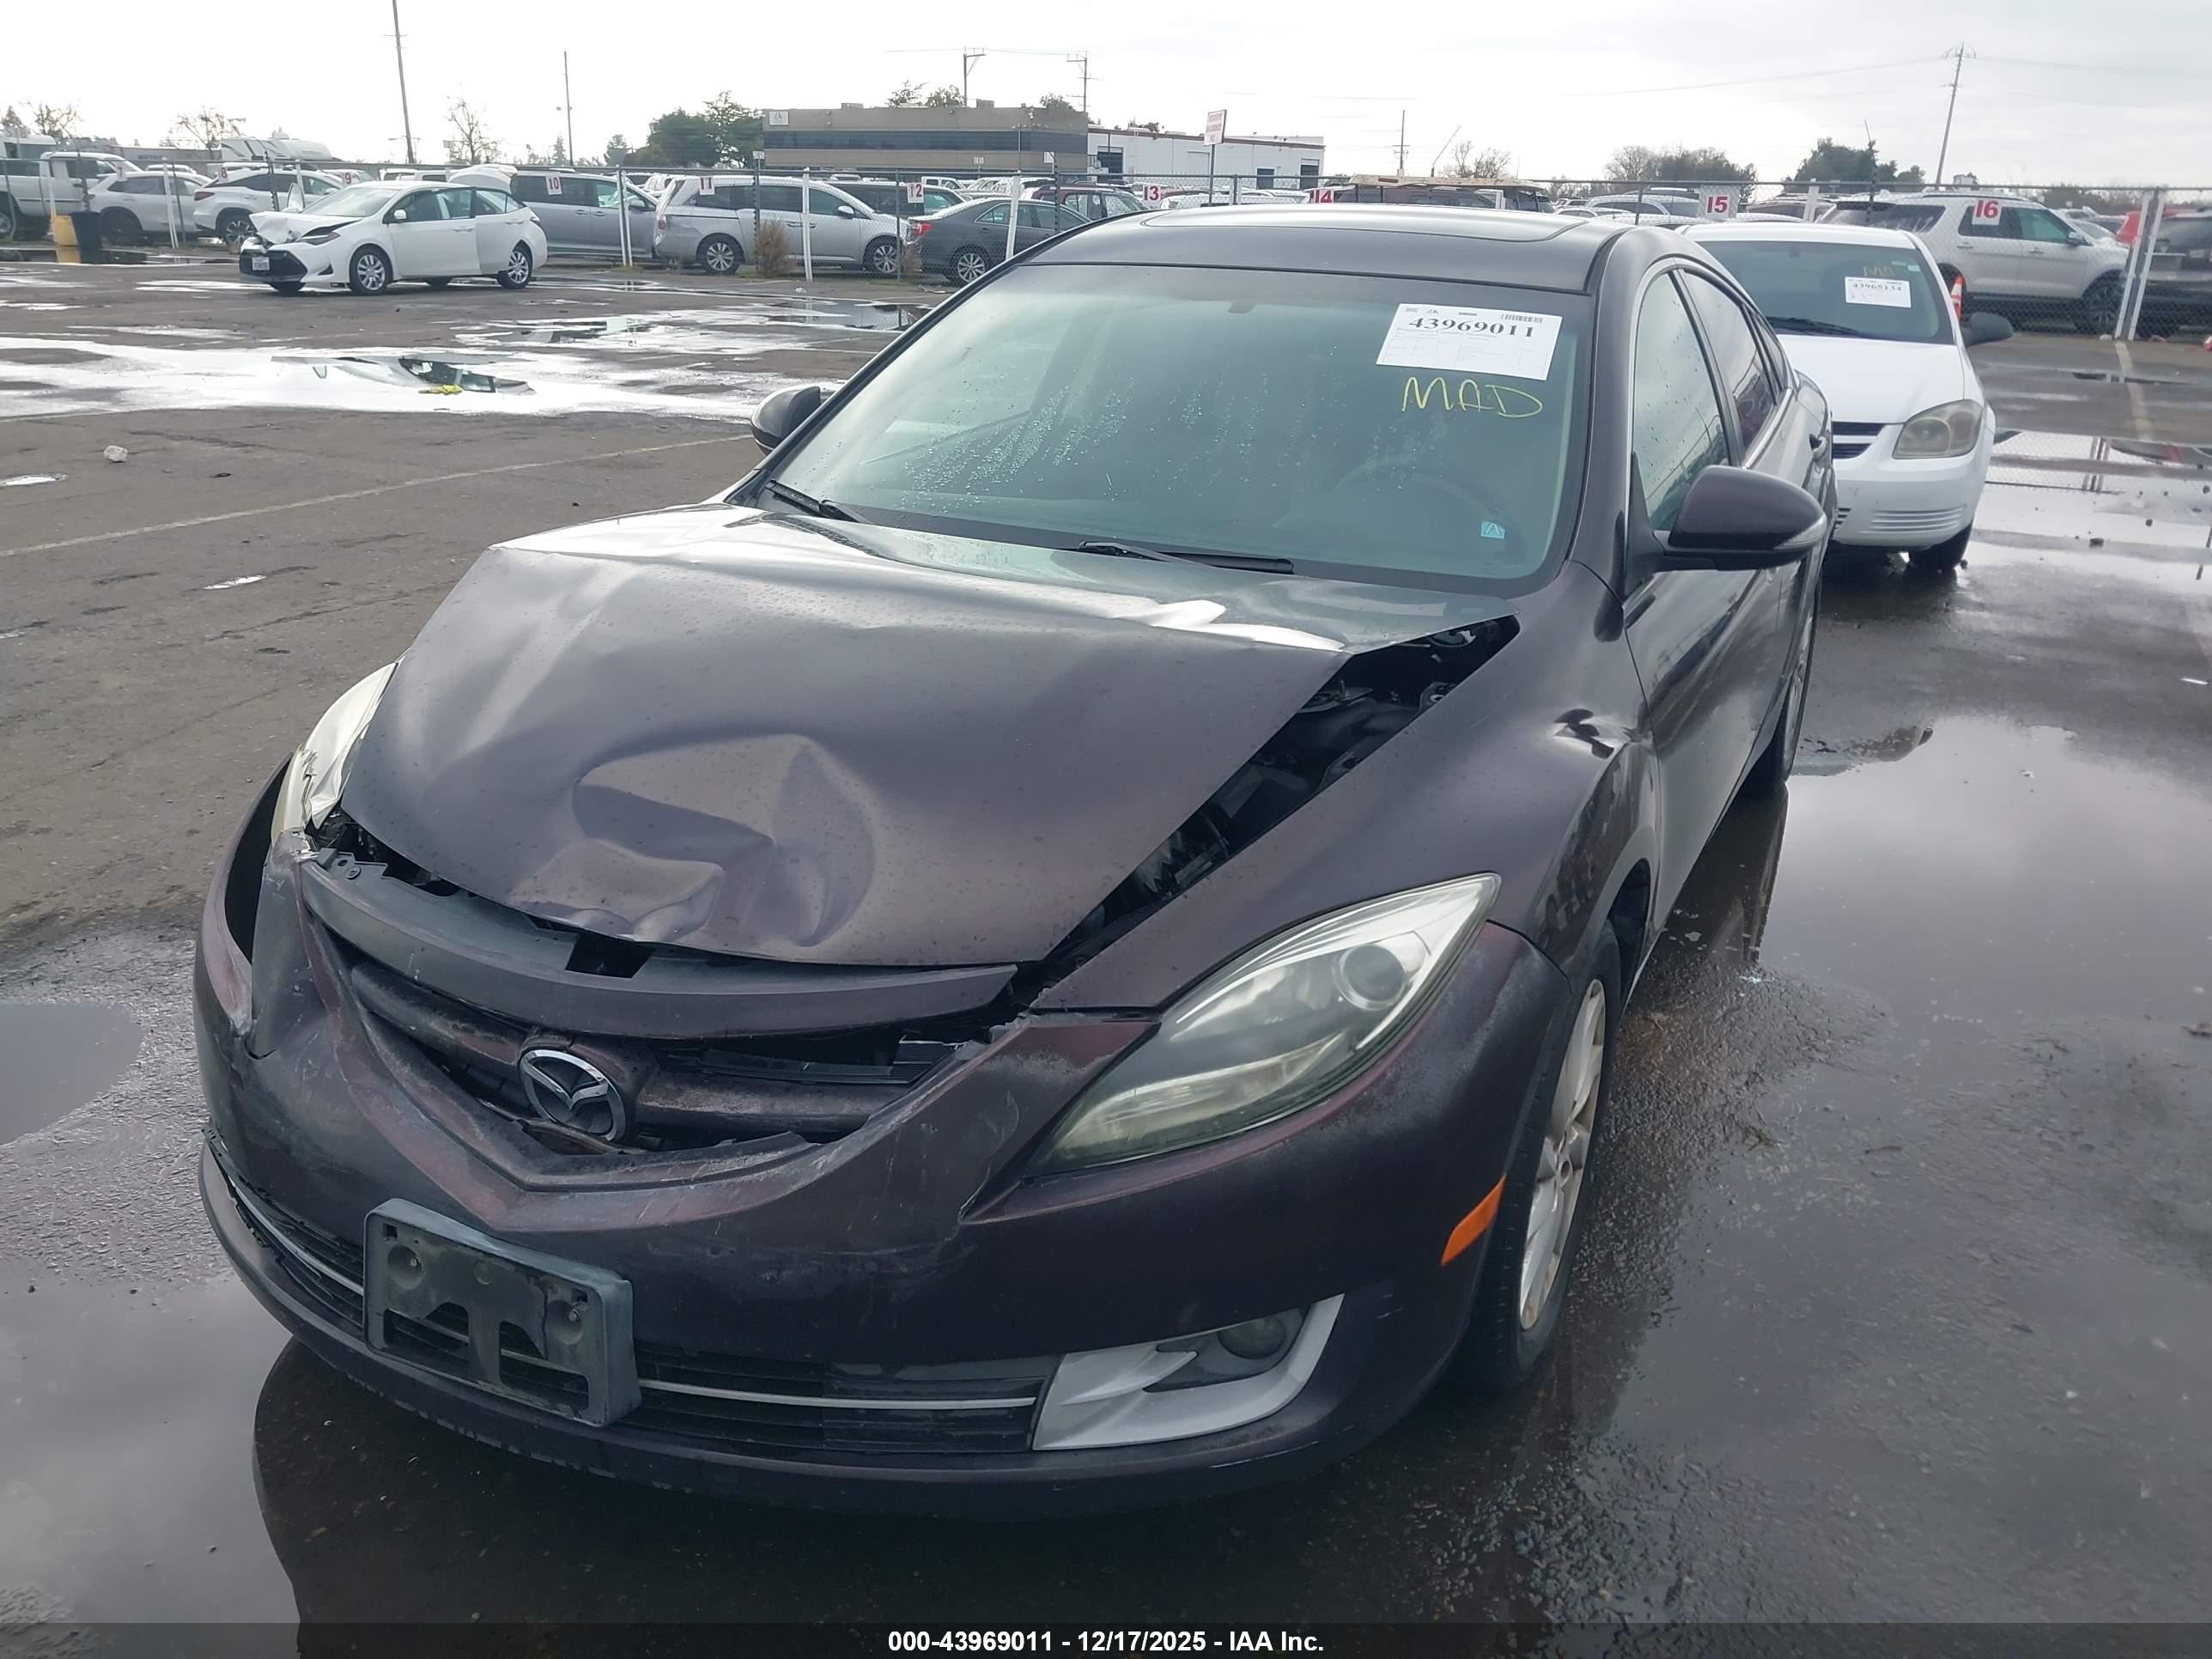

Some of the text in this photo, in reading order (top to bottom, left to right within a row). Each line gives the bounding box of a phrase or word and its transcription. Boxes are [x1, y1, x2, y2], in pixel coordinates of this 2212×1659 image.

[221, 167, 227, 179] 8
[345, 173, 351, 184] 9
[549, 177, 559, 190] 10
[700, 177, 712, 190] 11
[910, 184, 923, 198] 12
[1144, 185, 1159, 201] 13
[1315, 190, 1332, 204] 14
[1707, 196, 1728, 214] 15
[1976, 199, 1999, 219] 16
[1408, 317, 1534, 338] 43969011
[1401, 377, 1543, 417] MAD
